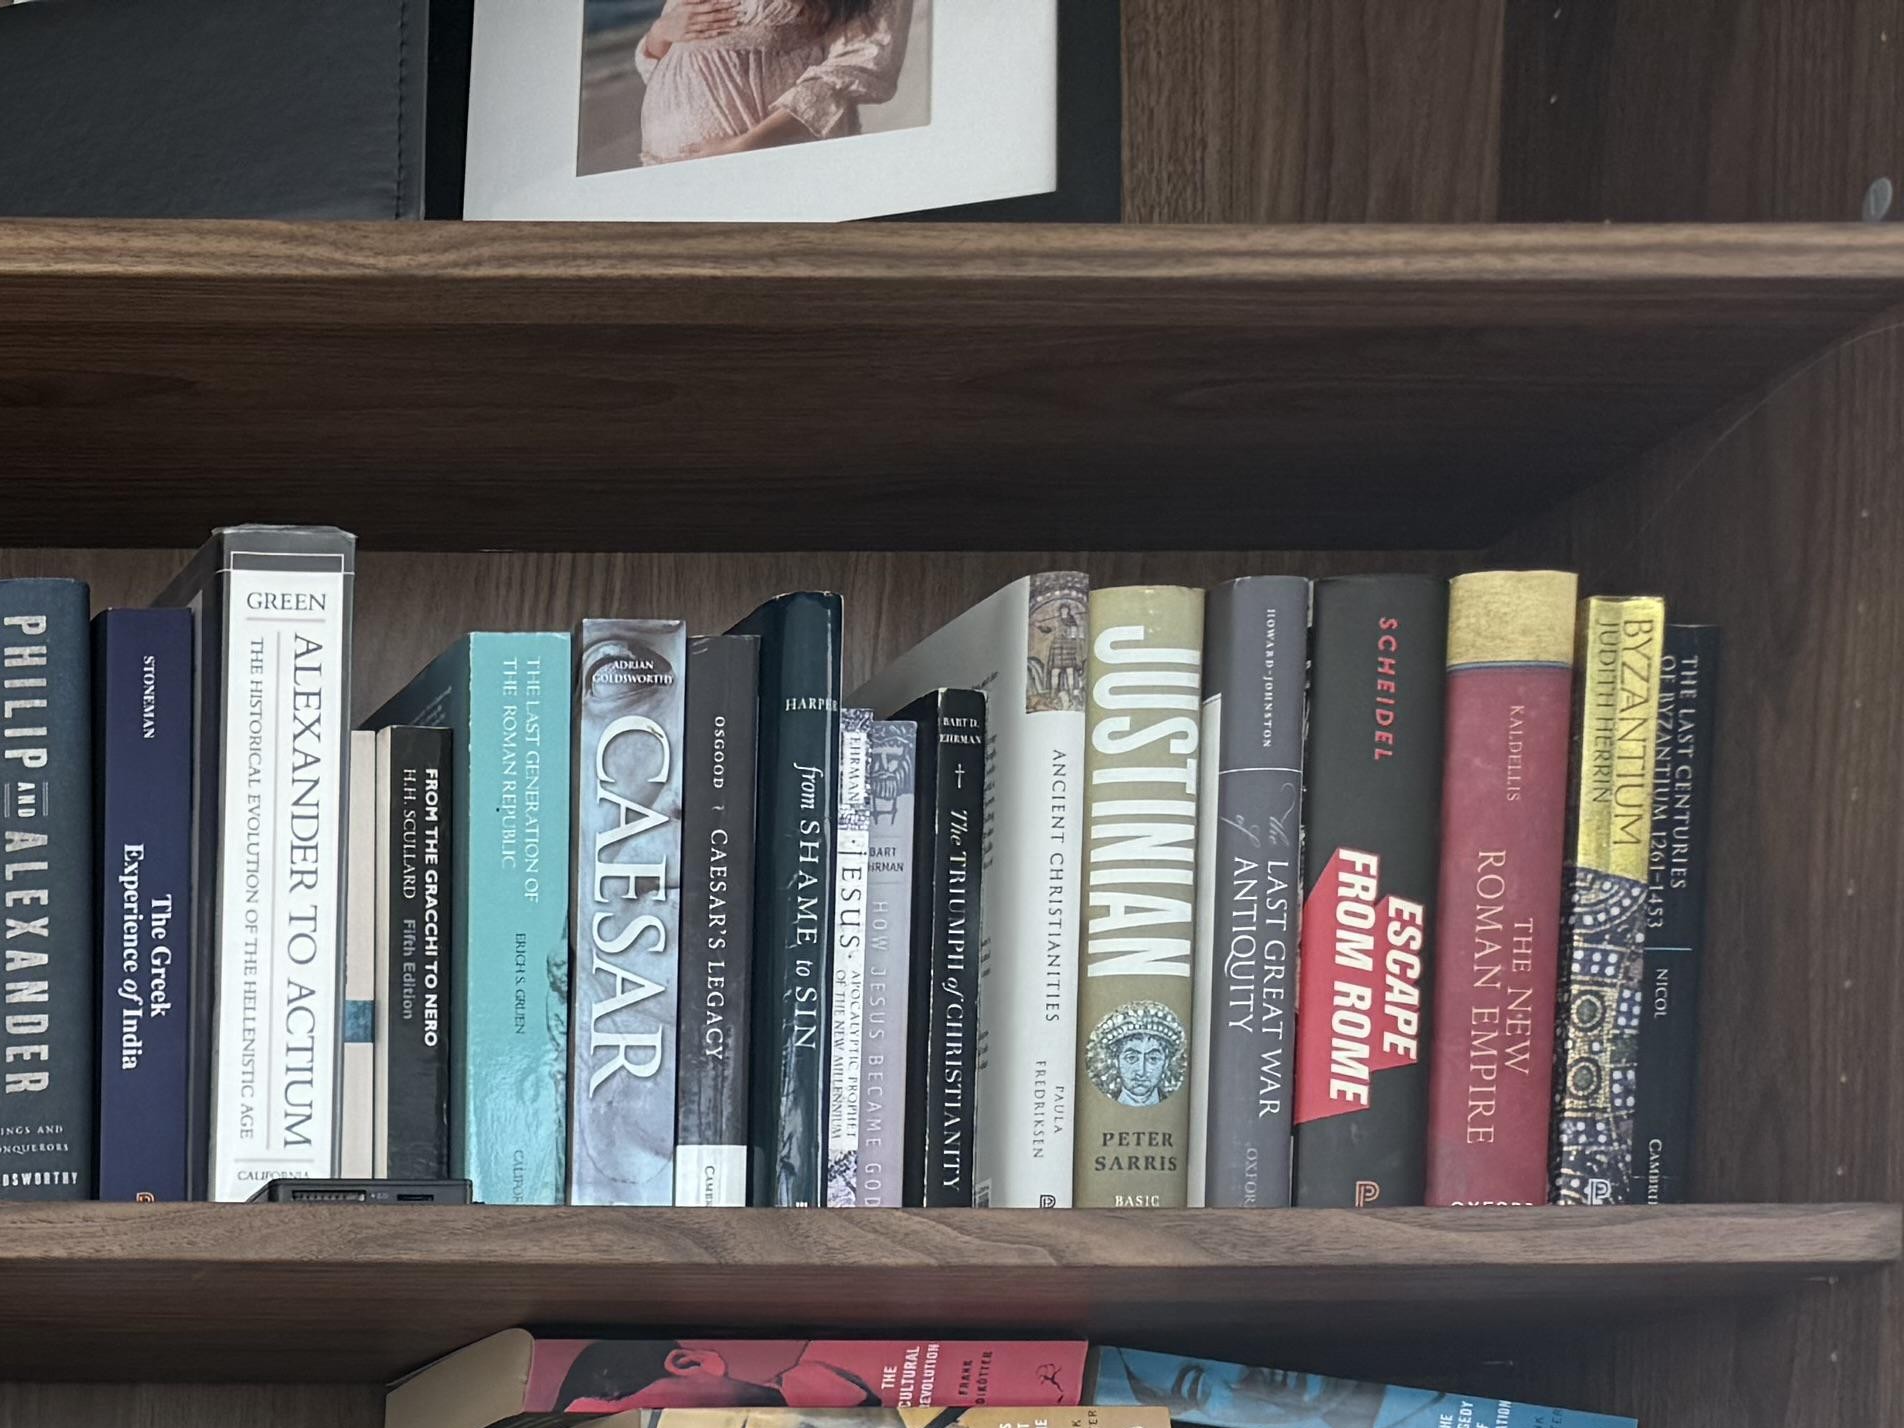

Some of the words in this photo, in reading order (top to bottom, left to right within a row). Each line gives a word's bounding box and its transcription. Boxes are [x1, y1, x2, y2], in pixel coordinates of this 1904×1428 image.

[246, 591, 327, 613] GREEN
[141, 655, 156, 739] STONEMAN
[1372, 616, 1399, 761] SCHEIDEL
[288, 633, 326, 893] ALEXANDER
[1086, 624, 1201, 978] JUSTINIAN
[290, 906, 320, 966] TO
[590, 713, 671, 1096] CAESAR
[1333, 847, 1380, 971] FROM
[1382, 896, 1423, 1060] ESCAPE
[282, 977, 320, 1152] ACTIUM
[1329, 979, 1375, 1108] ROME
[1093, 1154, 1177, 1174] SARRIS
[1101, 1131, 1174, 1149] PETER
